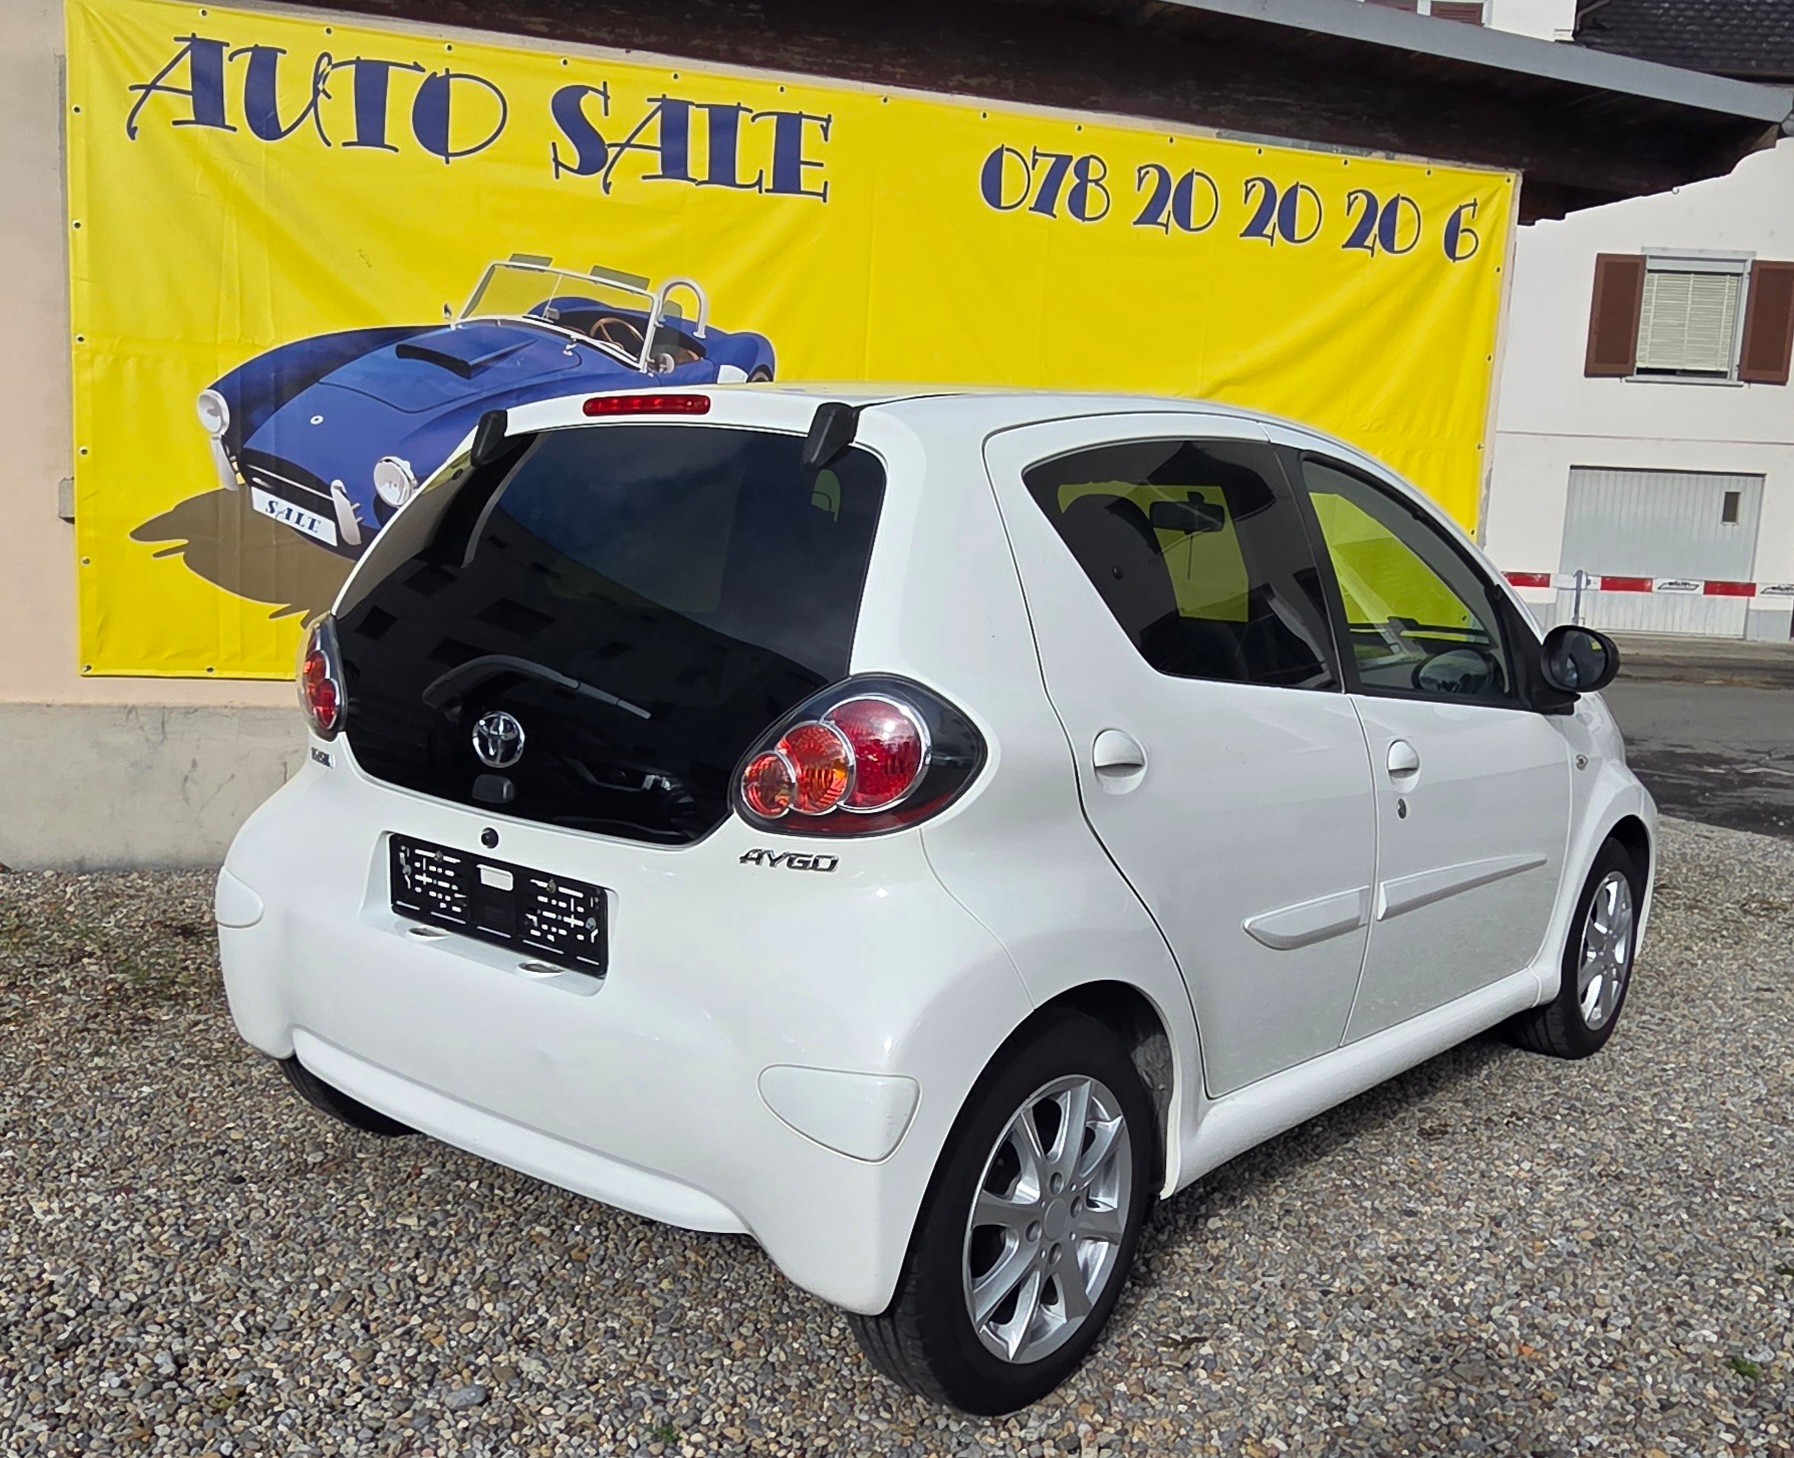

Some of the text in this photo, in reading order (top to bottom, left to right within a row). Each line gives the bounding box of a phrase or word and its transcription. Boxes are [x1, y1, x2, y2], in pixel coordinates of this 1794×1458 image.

[126, 32, 832, 204] AUTO SALE
[980, 143, 1479, 263] 078 20 20 20 6
[265, 500, 321, 534] SALE
[738, 848, 839, 873] AYGO
